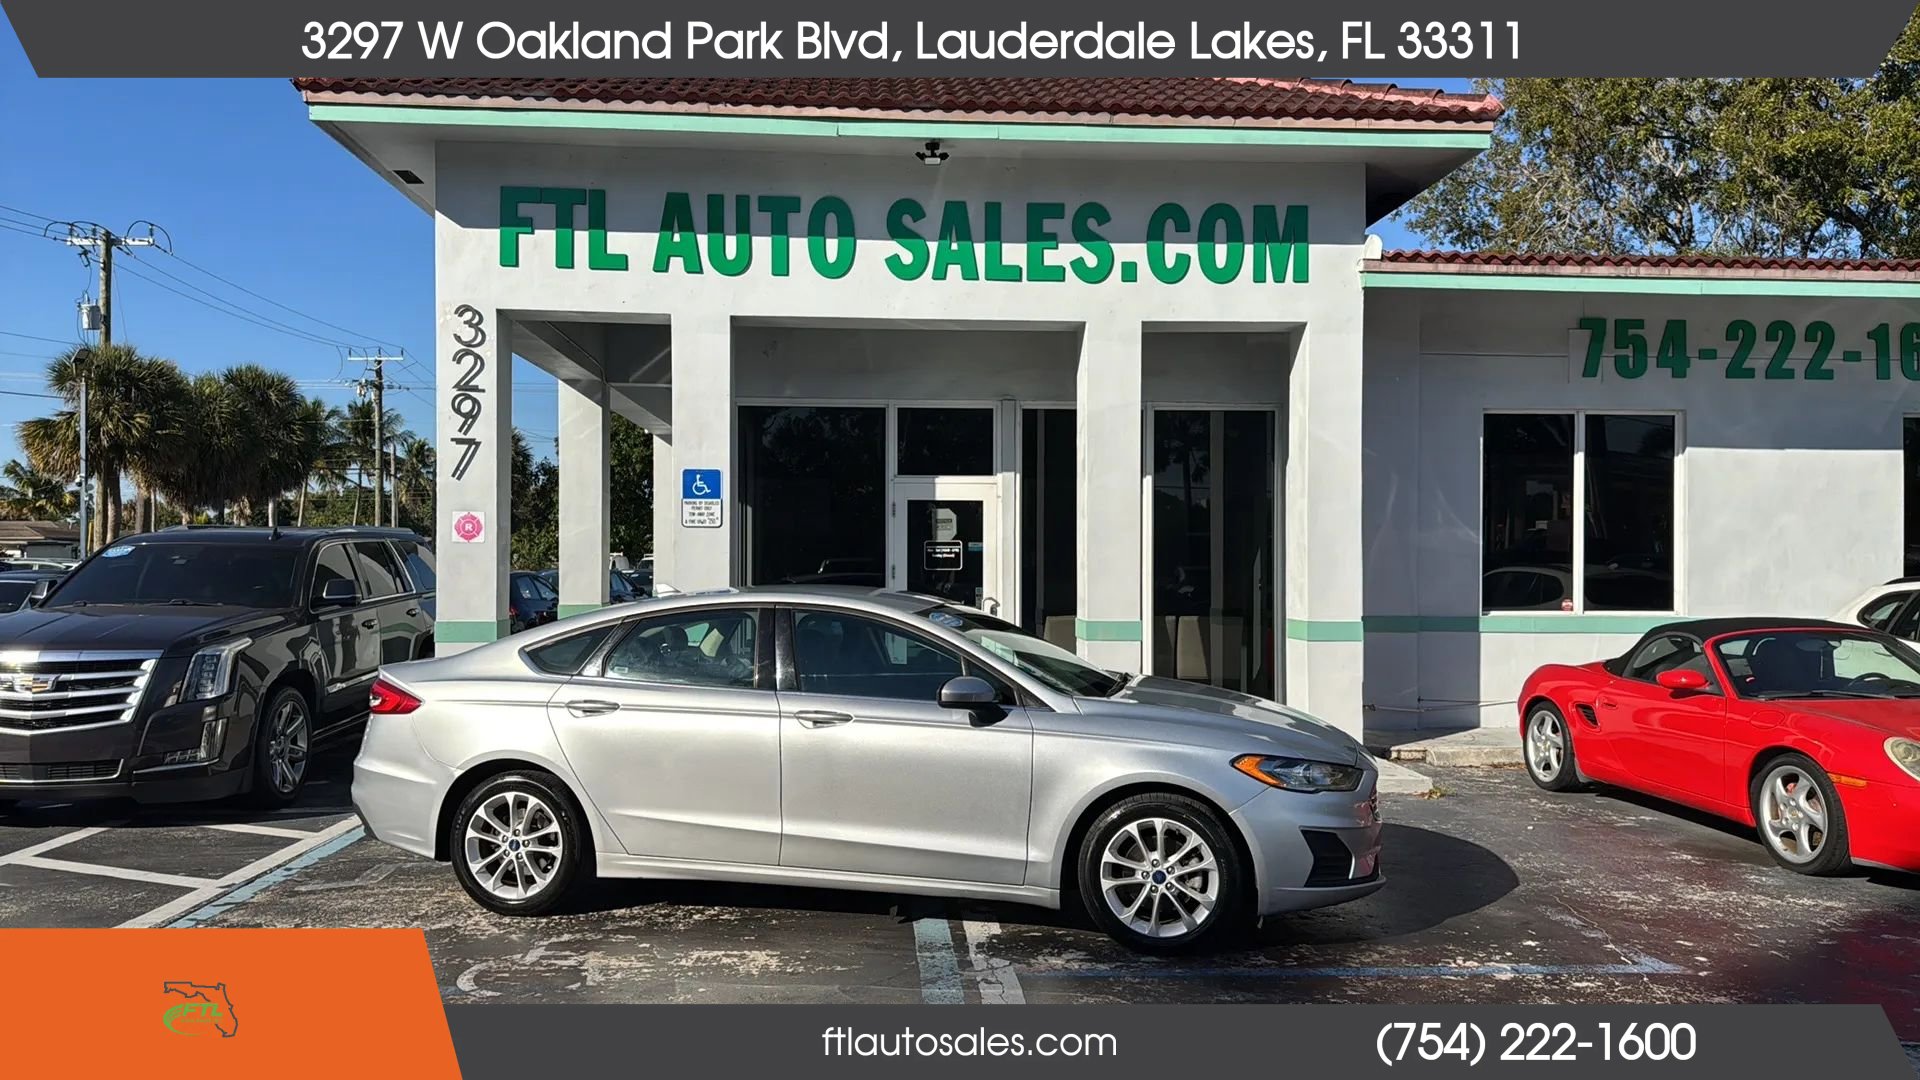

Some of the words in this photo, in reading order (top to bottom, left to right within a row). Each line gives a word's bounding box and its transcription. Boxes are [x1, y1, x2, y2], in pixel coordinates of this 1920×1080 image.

[498, 186, 630, 271] FTL
[653, 191, 857, 280] AUTO
[885, 198, 1310, 285] SALES.COM
[450, 304, 487, 481] 3297
[463, 523, 474, 532] R
